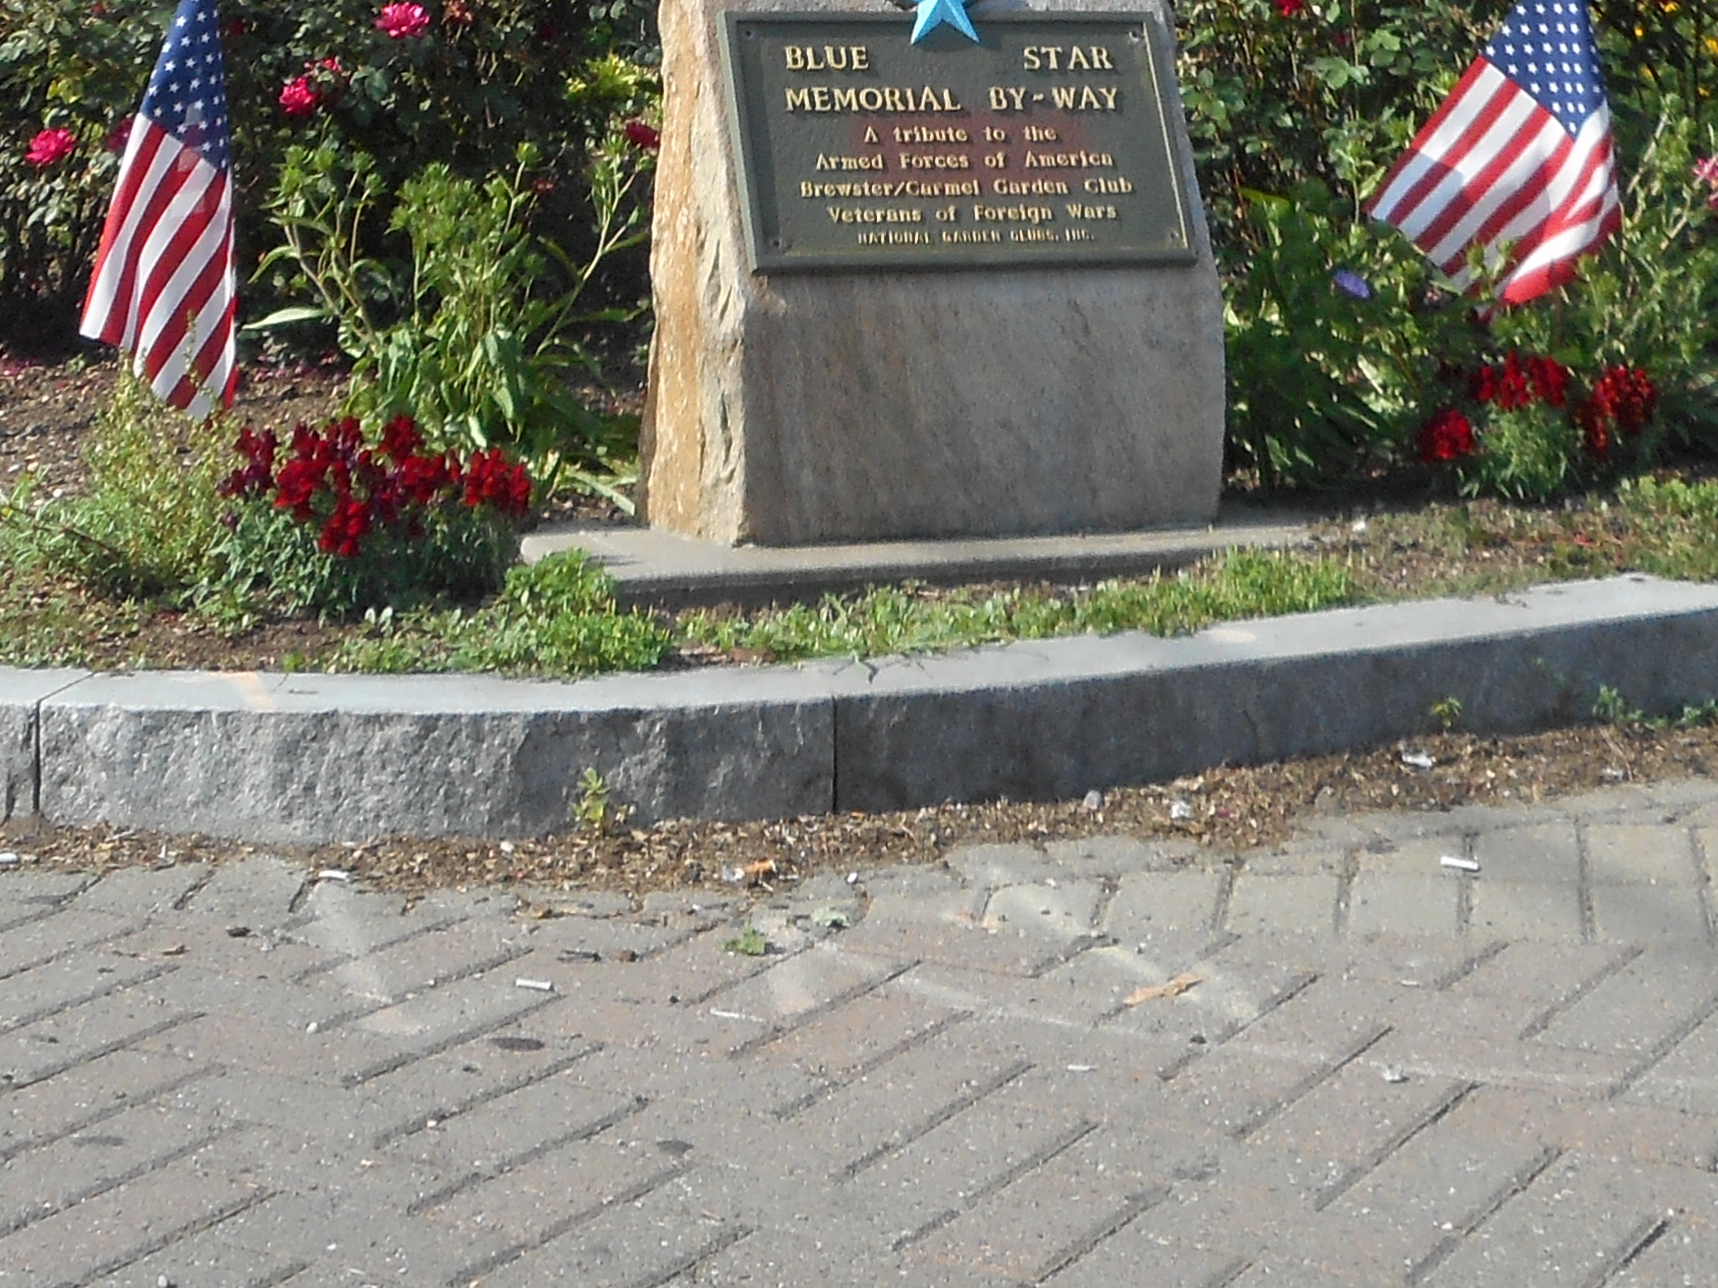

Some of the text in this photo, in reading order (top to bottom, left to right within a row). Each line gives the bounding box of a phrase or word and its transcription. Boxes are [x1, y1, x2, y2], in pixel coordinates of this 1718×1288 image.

[784, 45, 1114, 71] BLUE STAR
[783, 86, 1119, 113] MEMORIAL BY-WAY
[864, 126, 1057, 142] A tribute to the
[815, 150, 1113, 171] Armed Forces of America
[800, 176, 1133, 198] Brewster/Carmel Garden Club
[827, 202, 1118, 224] Veterans of Foreign Wars
[857, 229, 932, 245] NATIONAL
[941, 229, 1002, 243] GARDEN
[1065, 228, 1096, 242] INC.
